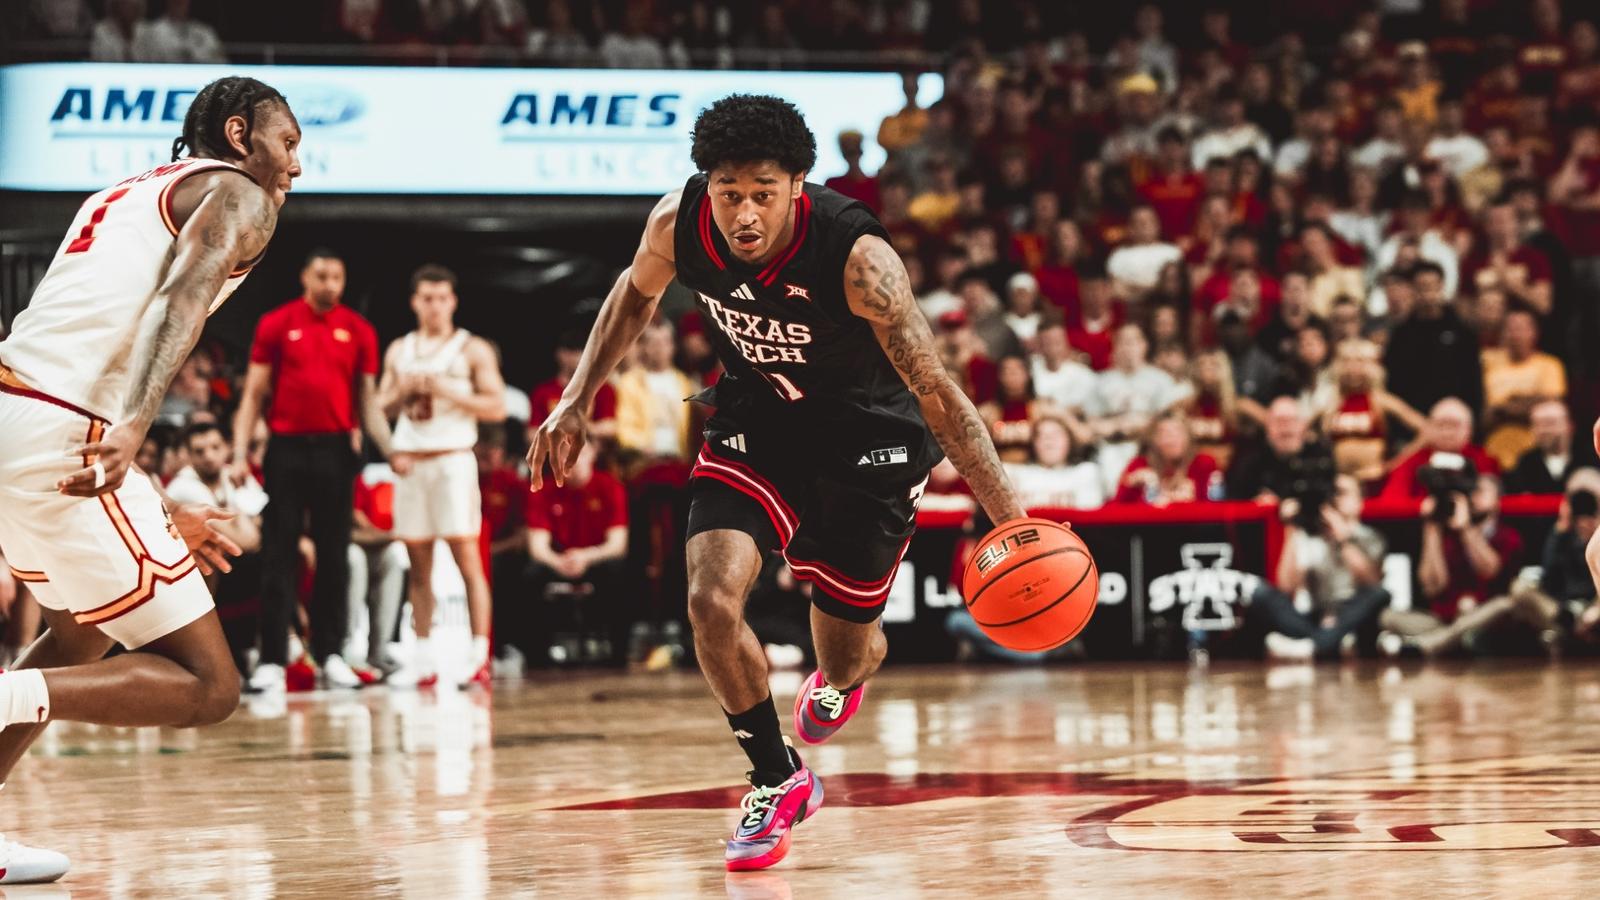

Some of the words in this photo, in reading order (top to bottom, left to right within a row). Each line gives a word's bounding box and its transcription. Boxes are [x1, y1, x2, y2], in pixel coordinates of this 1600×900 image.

[50, 87, 197, 121] AME
[501, 93, 681, 127] AMES
[64, 187, 131, 254] 1
[696, 289, 812, 344] TEXAS
[718, 322, 807, 363] TECH
[975, 527, 1042, 573] ELITE
